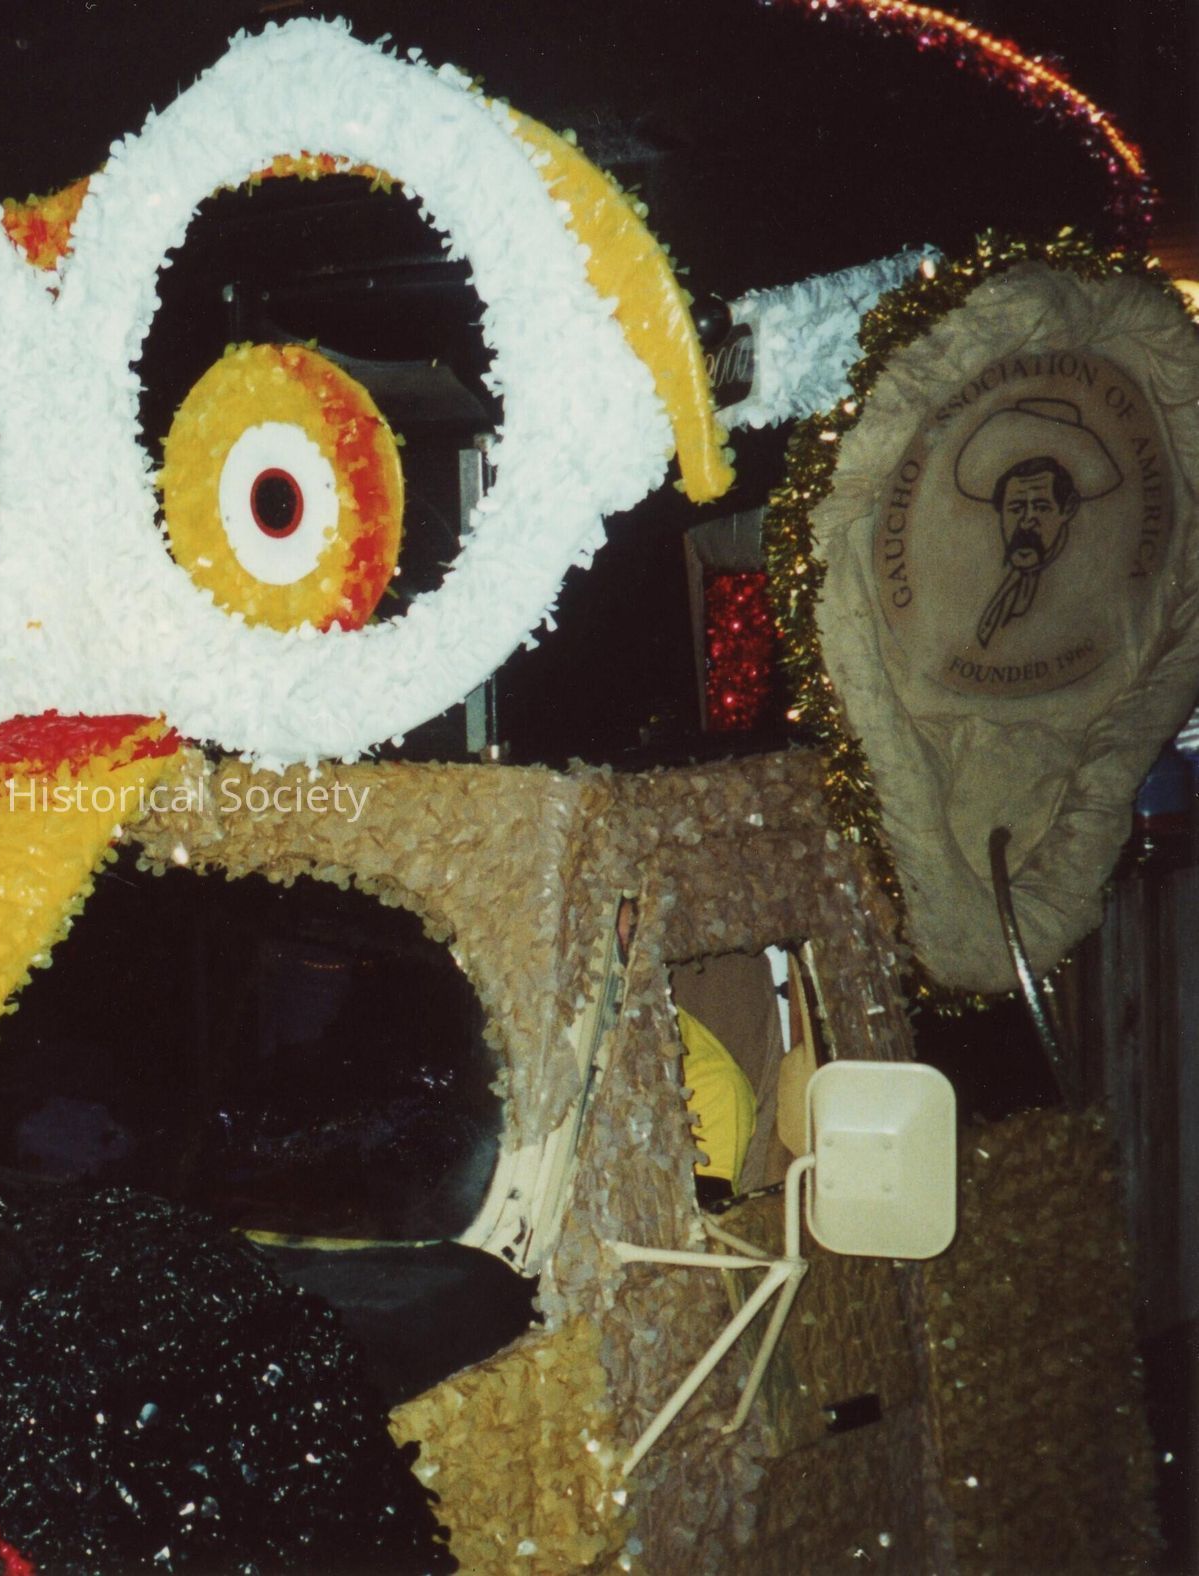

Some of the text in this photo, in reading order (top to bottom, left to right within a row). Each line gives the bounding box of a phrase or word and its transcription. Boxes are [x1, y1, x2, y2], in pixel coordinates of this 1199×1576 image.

[885, 353, 1162, 609] GAUCHO SSOCIATION OF AMERICA
[949, 656, 1050, 683] FOUNDED
